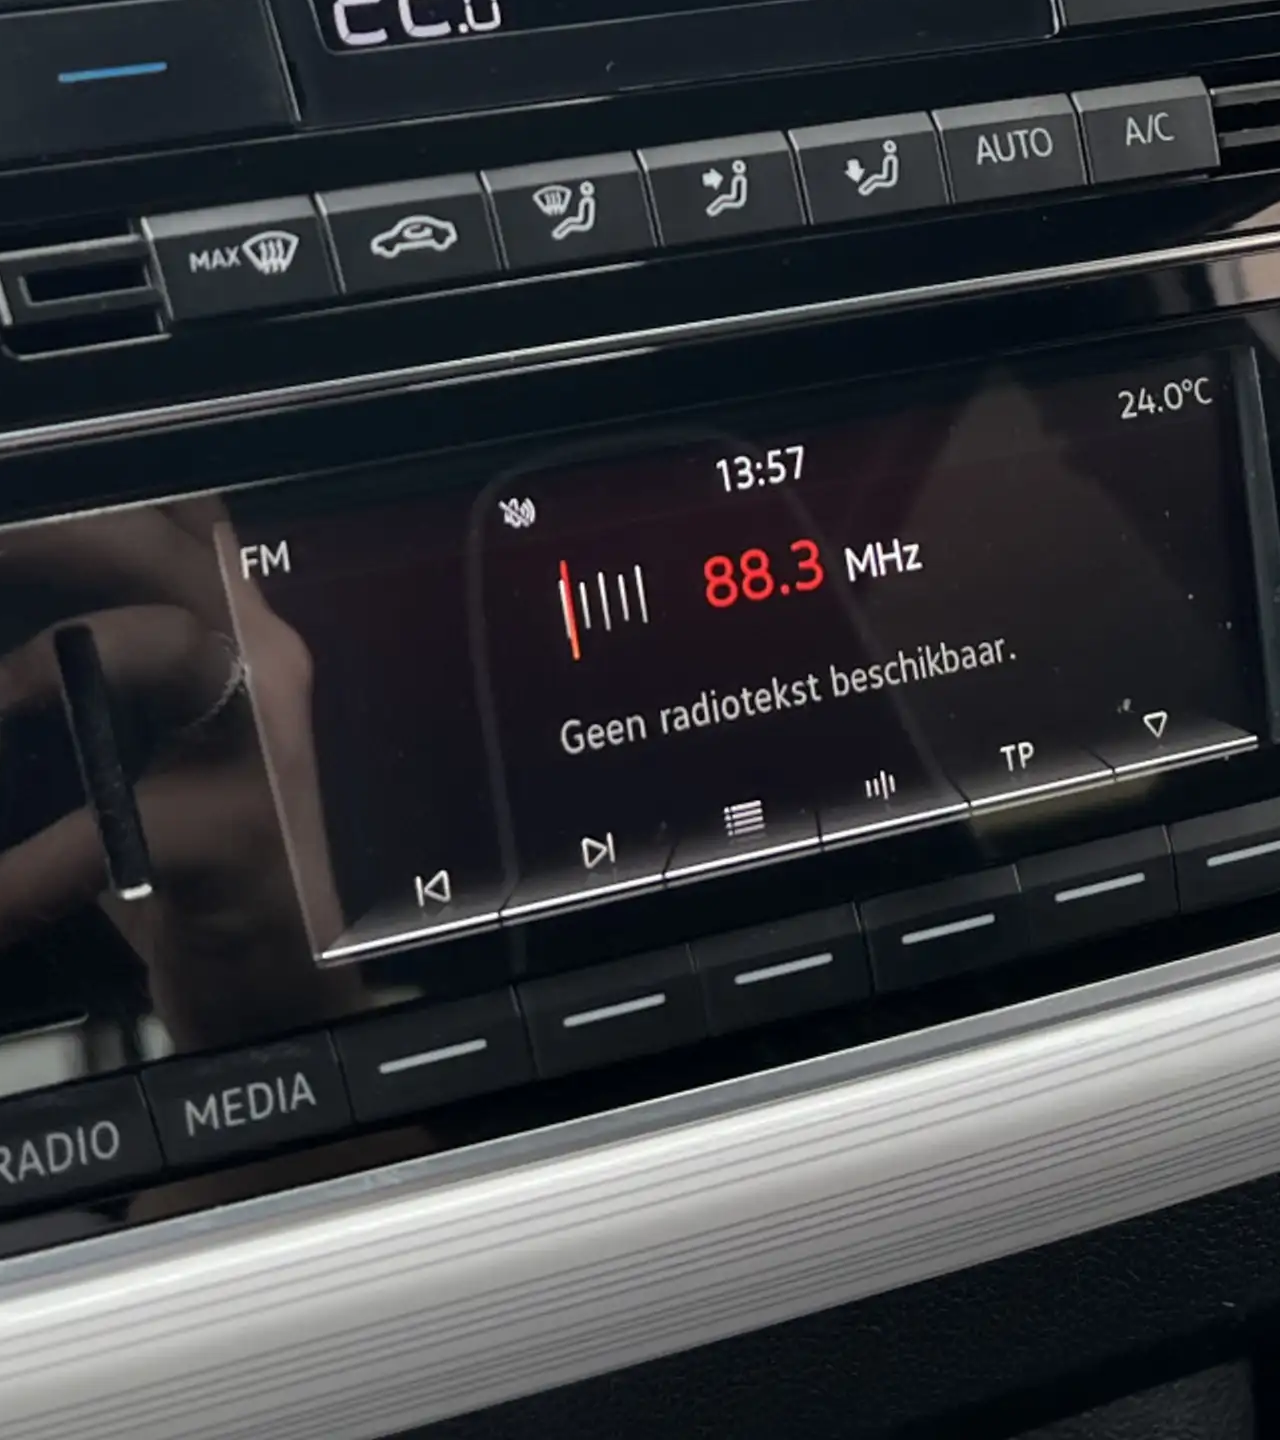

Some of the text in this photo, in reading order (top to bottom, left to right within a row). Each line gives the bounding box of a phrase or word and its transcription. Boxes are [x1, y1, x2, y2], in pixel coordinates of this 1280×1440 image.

[975, 126, 1054, 166] AUTO
[1123, 108, 1175, 148] A/C
[188, 245, 241, 273] MAX
[1117, 376, 1213, 420] 24.0°C
[716, 446, 806, 493] 13:57
[239, 540, 292, 582] FM
[702, 538, 923, 610] 88.3 MHz
[559, 635, 1018, 757] Geen radiotekst beschikbaar.
[1000, 742, 1035, 773] TP
[183, 1071, 317, 1138] MEDIA
